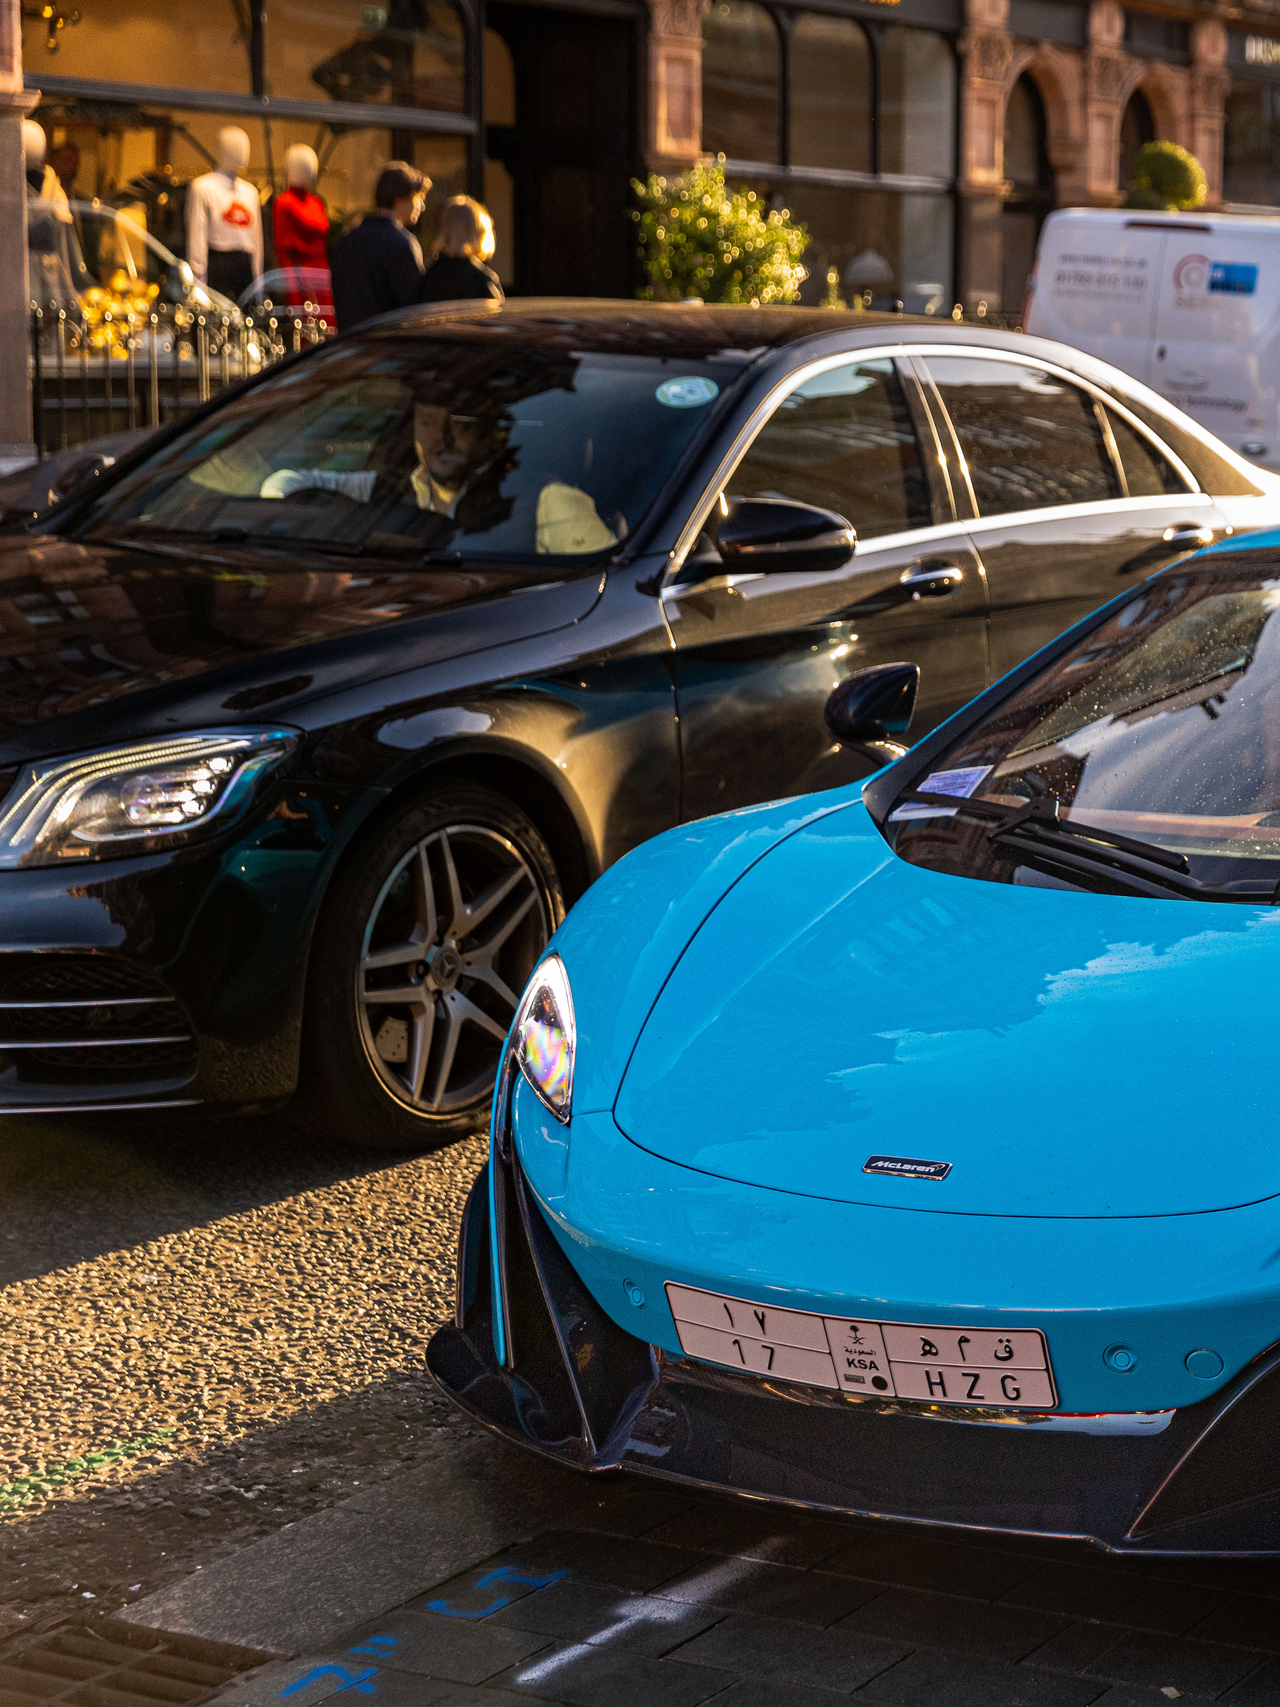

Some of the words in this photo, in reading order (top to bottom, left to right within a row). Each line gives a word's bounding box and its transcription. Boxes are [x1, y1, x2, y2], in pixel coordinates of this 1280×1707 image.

[871, 1161, 936, 1173] McLaren
[732, 1338, 774, 1371] 17
[846, 1358, 880, 1372] KSA
